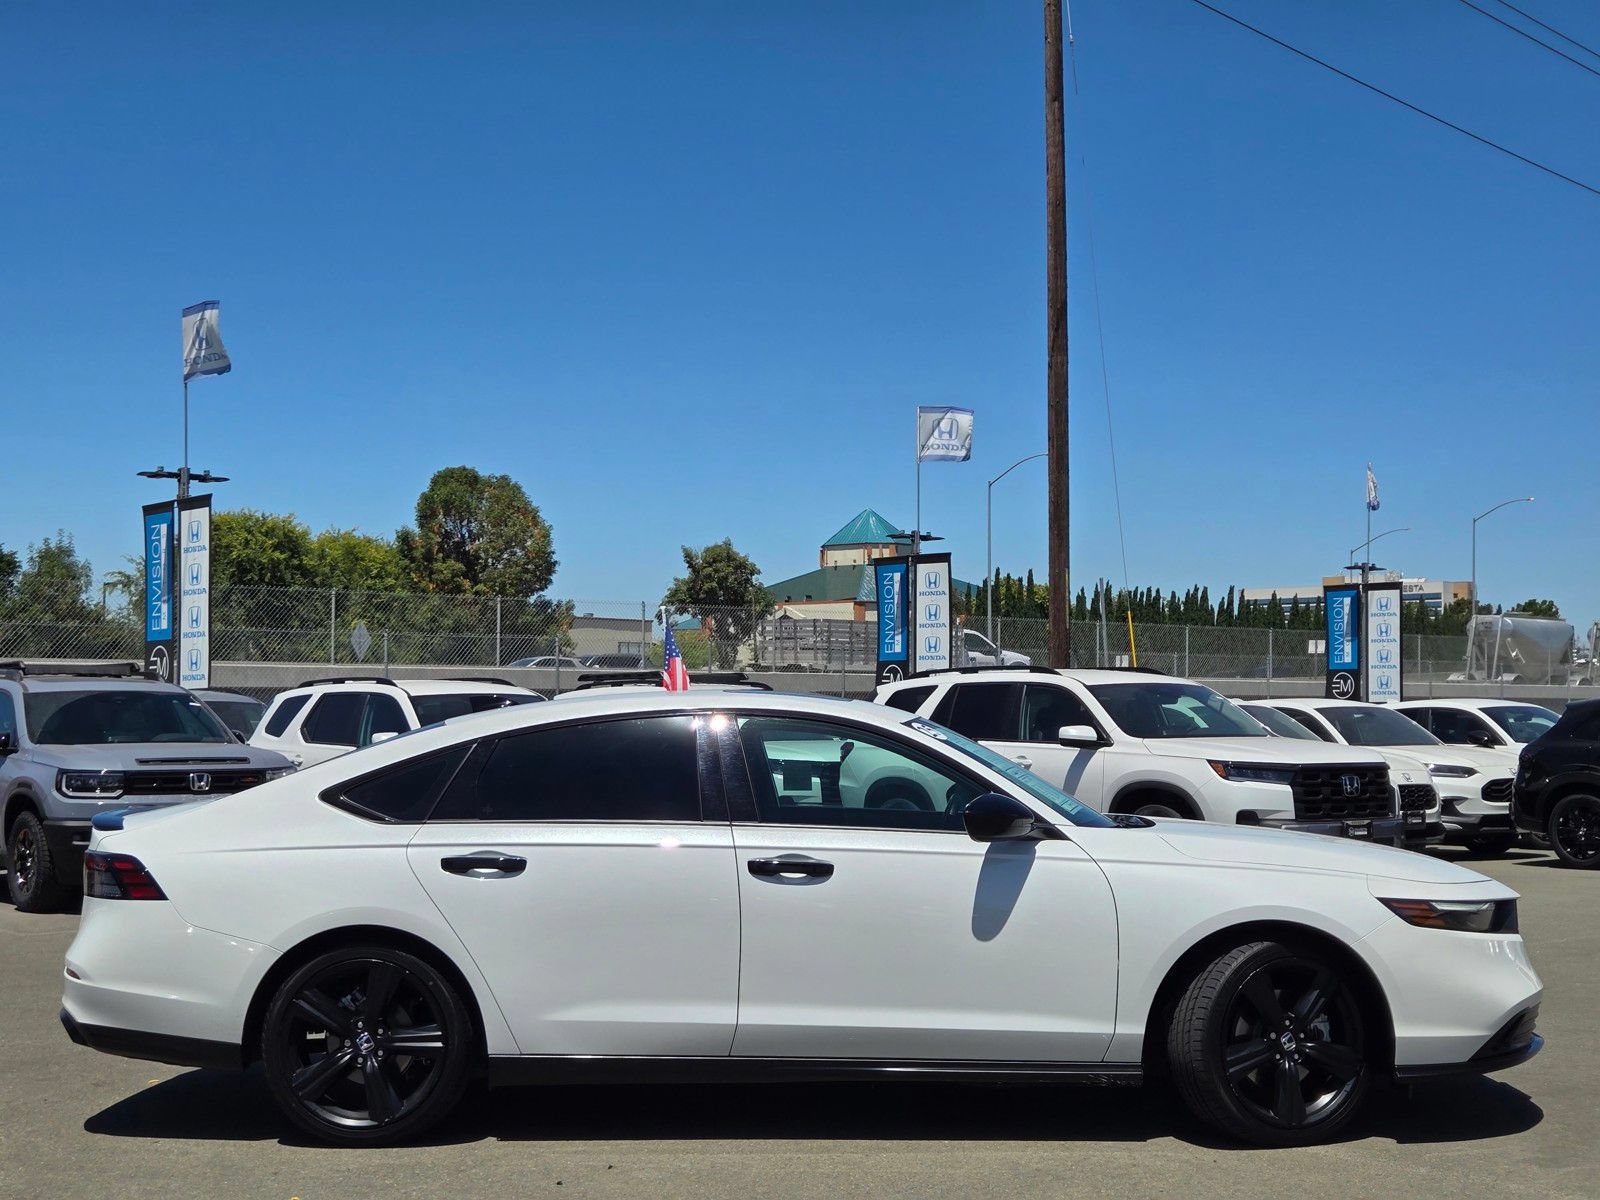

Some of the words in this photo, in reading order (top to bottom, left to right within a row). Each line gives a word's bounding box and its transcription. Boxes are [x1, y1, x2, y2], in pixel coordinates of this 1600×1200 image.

[183, 544, 207, 554] HONDA
[151, 523, 162, 631] ENVISION
[183, 587, 207, 597] HONDA
[883, 572, 895, 654] ENVISION
[182, 630, 206, 639] HONDA
[1333, 597, 1344, 664] ENVISION
[182, 674, 206, 682] HONDA
